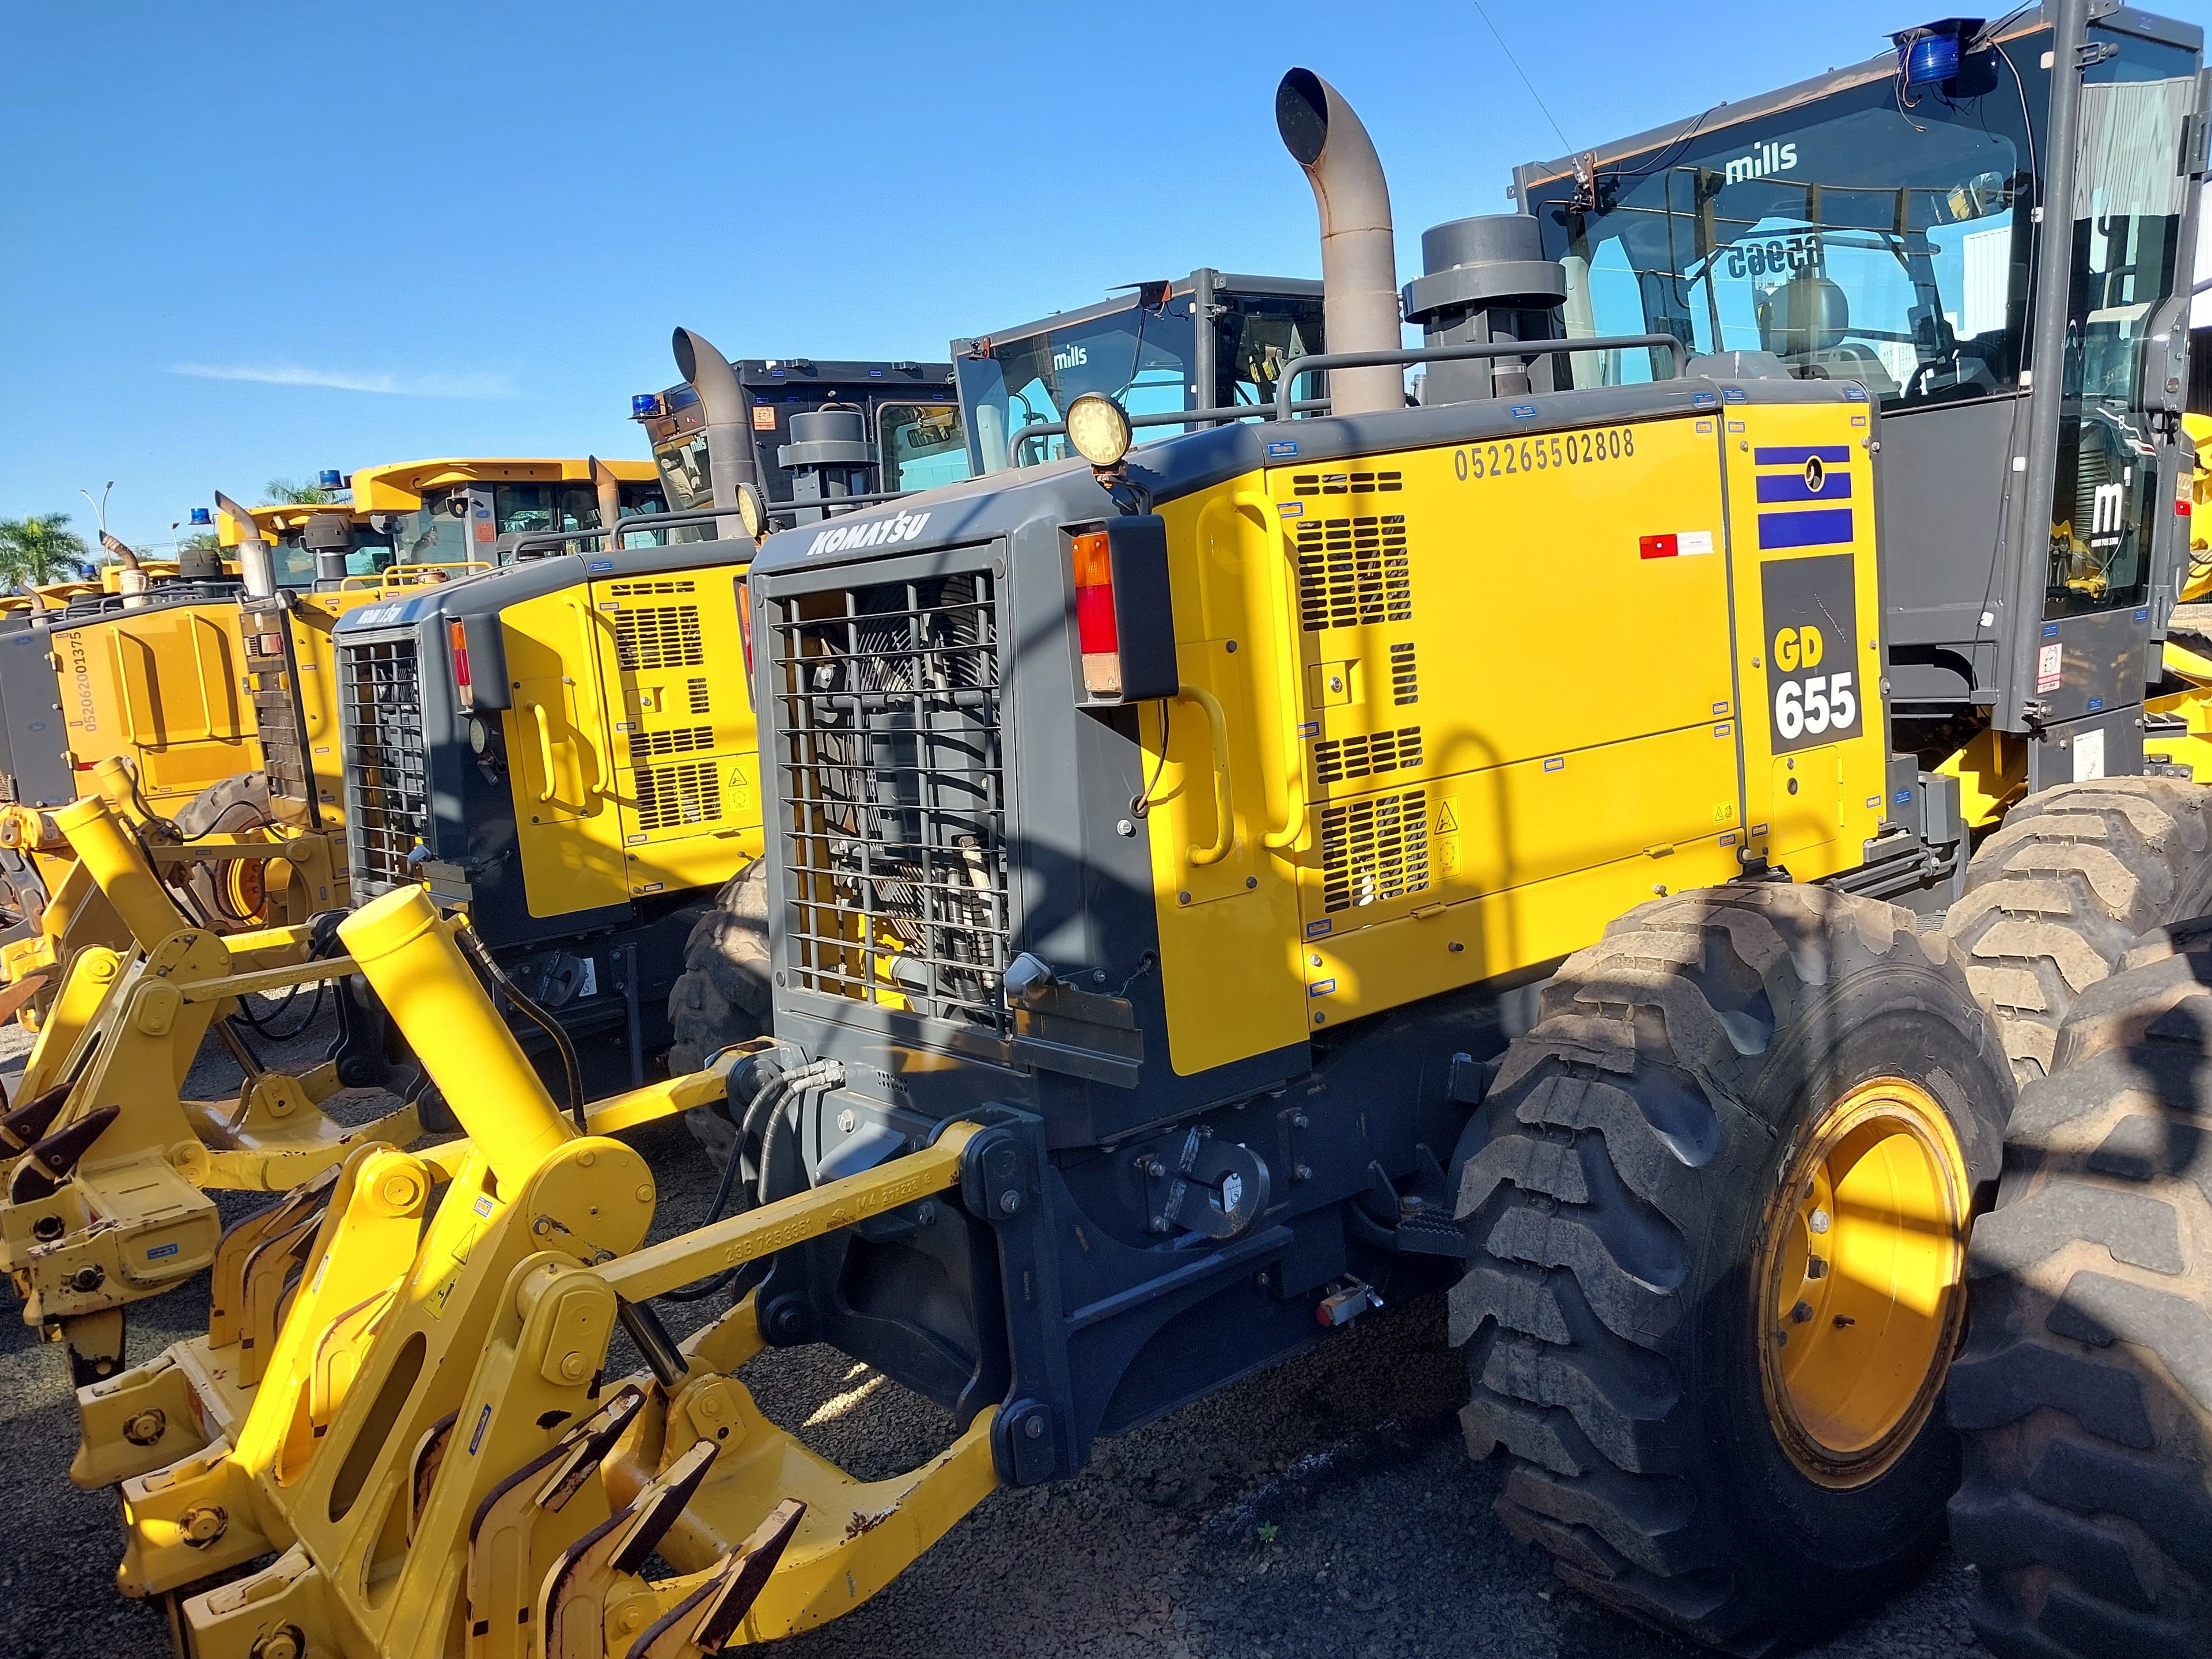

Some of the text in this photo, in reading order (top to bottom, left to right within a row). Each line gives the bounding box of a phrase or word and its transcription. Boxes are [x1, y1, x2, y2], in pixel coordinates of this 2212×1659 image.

[1726, 142, 1797, 185] mills
[1054, 344, 1087, 371] mills
[690, 434, 707, 453] mills
[1455, 428, 1634, 481] 052265502808
[2092, 483, 2122, 533] m
[806, 510, 931, 556] KOMATSU
[355, 604, 403, 624] KOMATSU
[1774, 626, 1823, 672] GD
[69, 631, 97, 732] 052062001375
[1775, 672, 1855, 740] 655
